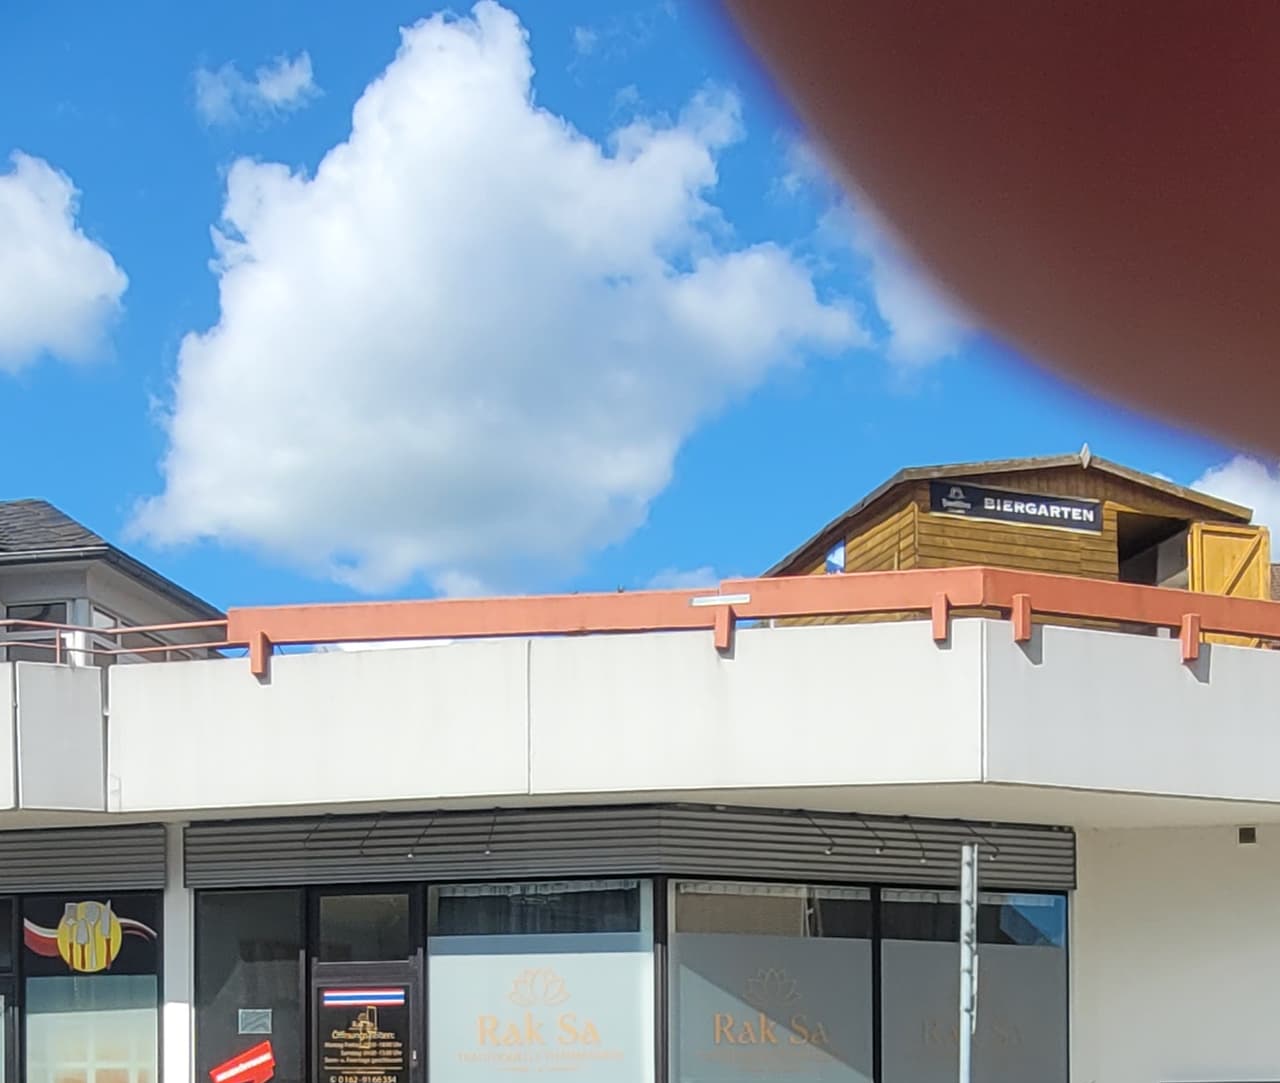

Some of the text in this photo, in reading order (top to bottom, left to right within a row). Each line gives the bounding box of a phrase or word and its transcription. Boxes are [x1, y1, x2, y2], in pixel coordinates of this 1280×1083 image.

[983, 497, 1095, 522] BIERGARTEN
[476, 1011, 601, 1047] Rak Sa
[713, 1012, 830, 1045] Rak Sa
